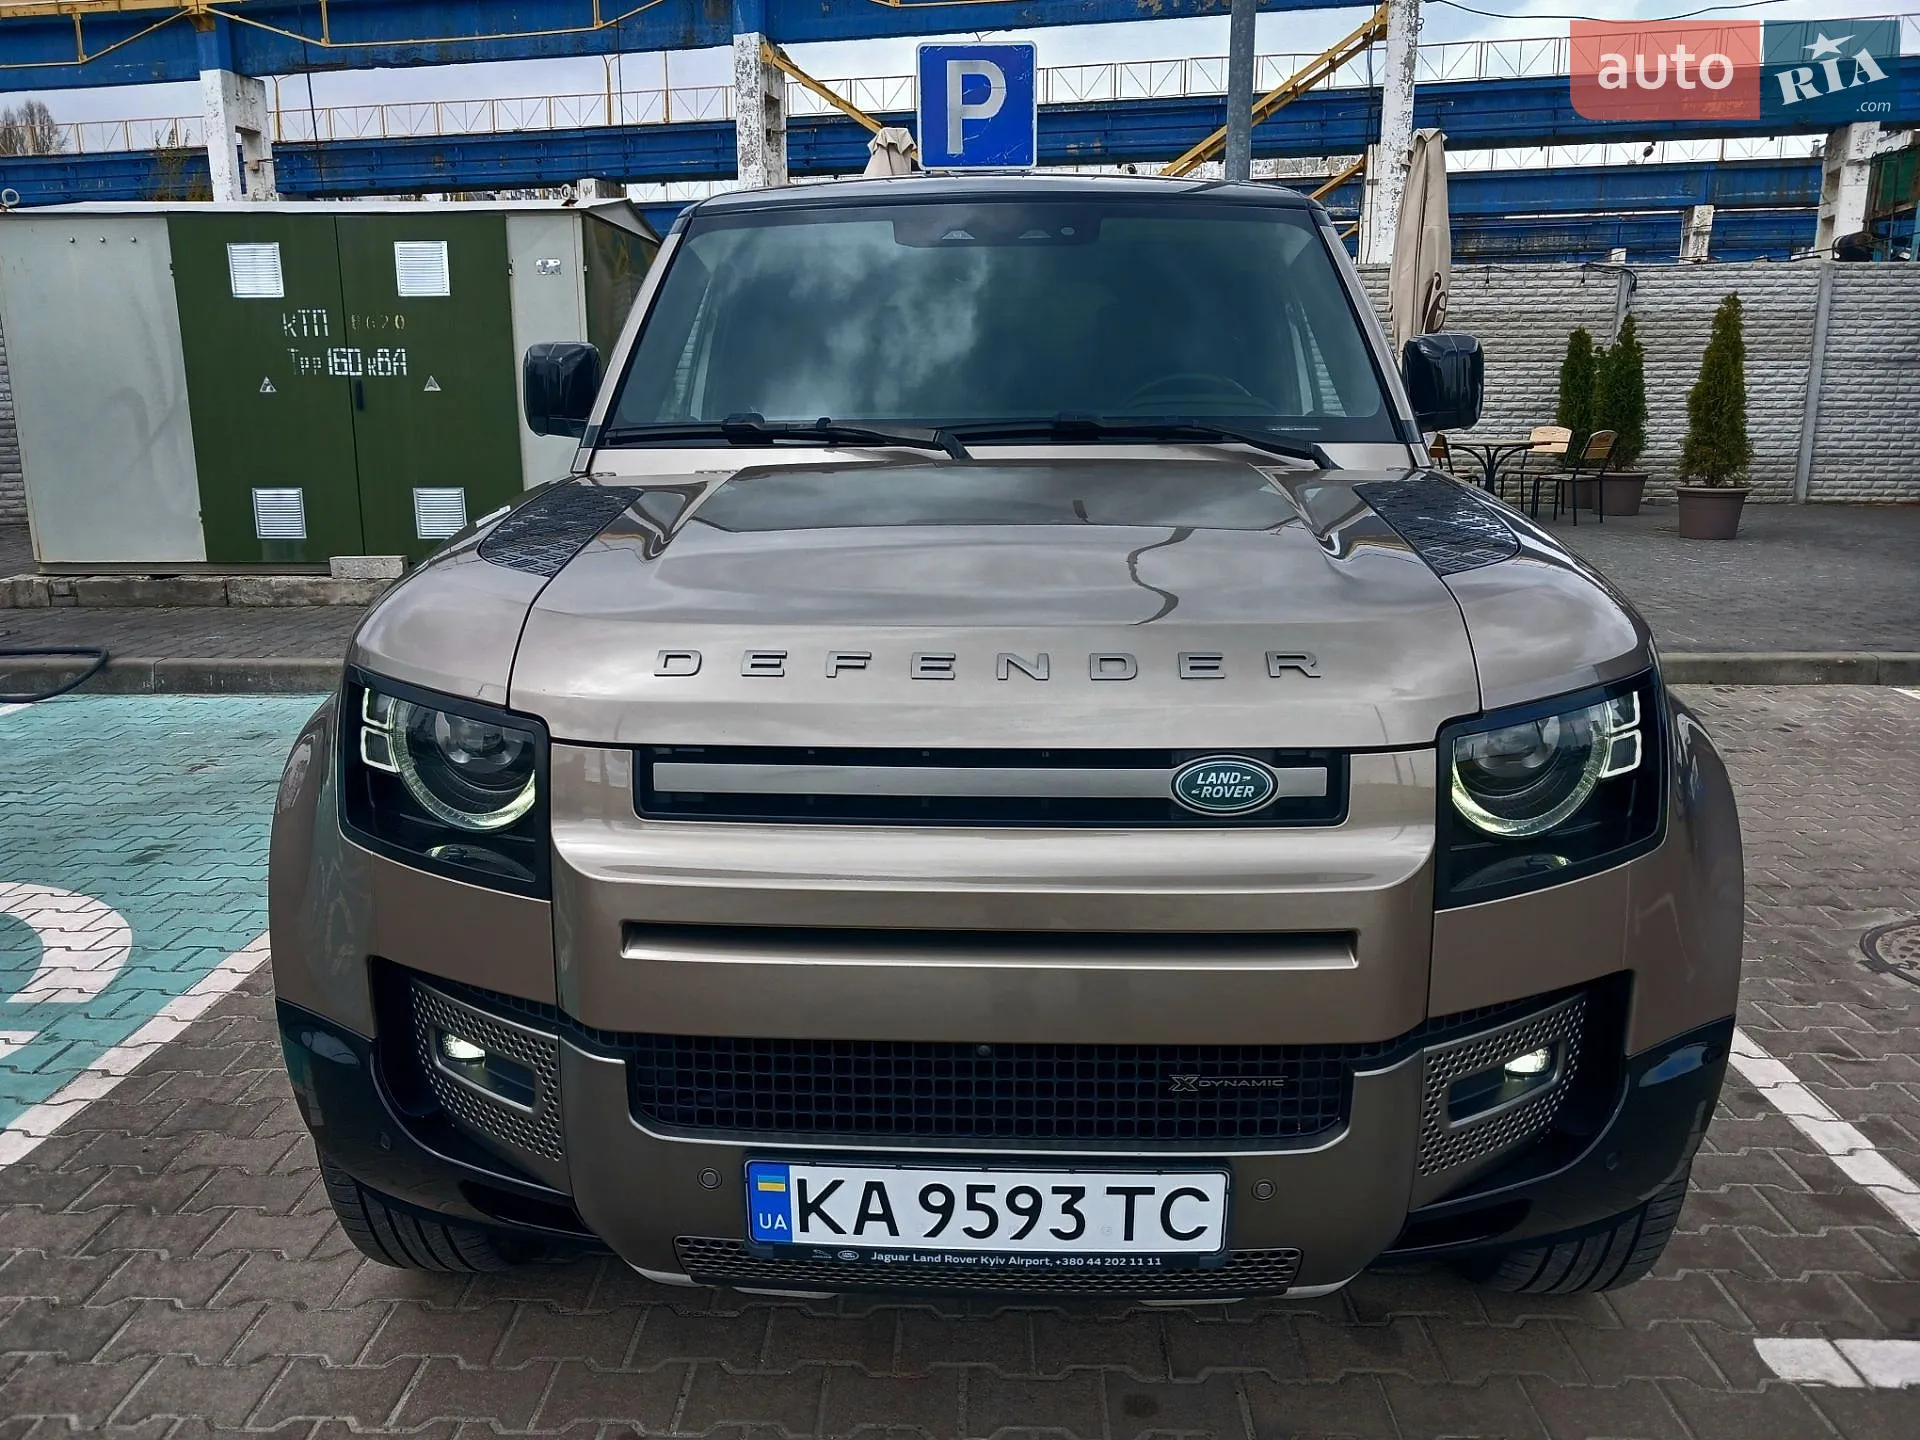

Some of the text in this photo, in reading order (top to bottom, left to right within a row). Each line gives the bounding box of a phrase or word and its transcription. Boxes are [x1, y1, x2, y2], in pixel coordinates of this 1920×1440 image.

[946, 60, 1007, 155] P
[654, 649, 1322, 681] DEFENDER
[1197, 772, 1241, 785] LAND
[1200, 785, 1255, 798] ROVER
[797, 1178, 1211, 1241] KA 9593 TC
[759, 1213, 788, 1230] UA
[871, 1252, 1162, 1267] Jaguar Land Rover Kyiv Airport, +380 44 202 11 11
